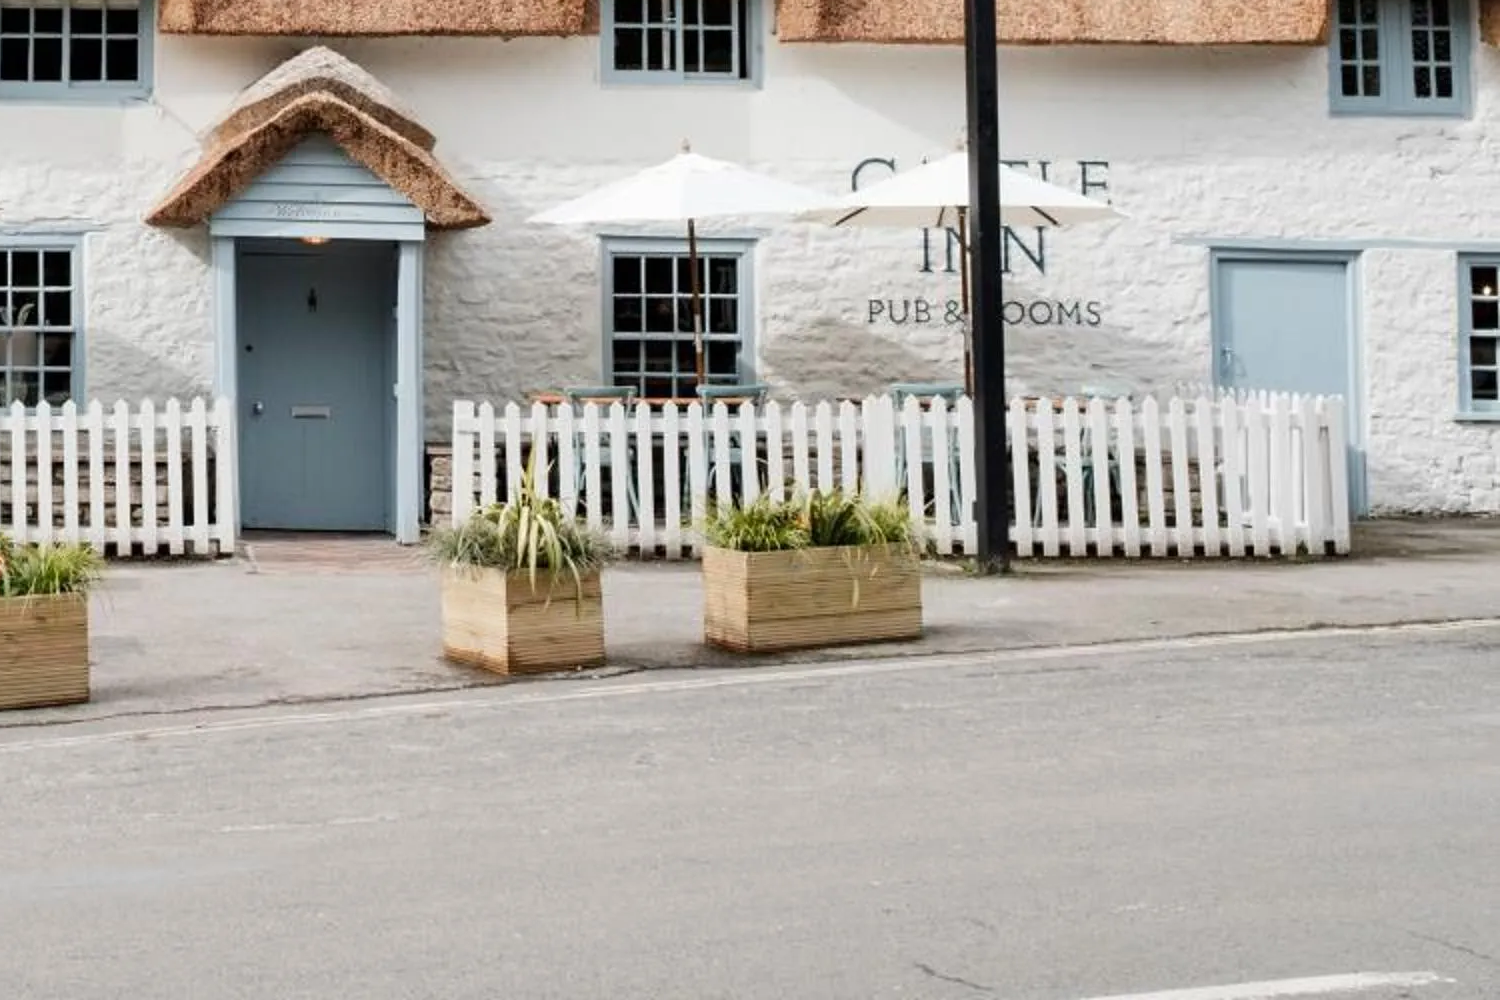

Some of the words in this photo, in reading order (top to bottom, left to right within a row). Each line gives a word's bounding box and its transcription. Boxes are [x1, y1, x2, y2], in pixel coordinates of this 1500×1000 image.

[867, 300, 931, 323] PUB
[944, 300, 966, 324] &
[1001, 301, 1101, 325] OOMS
